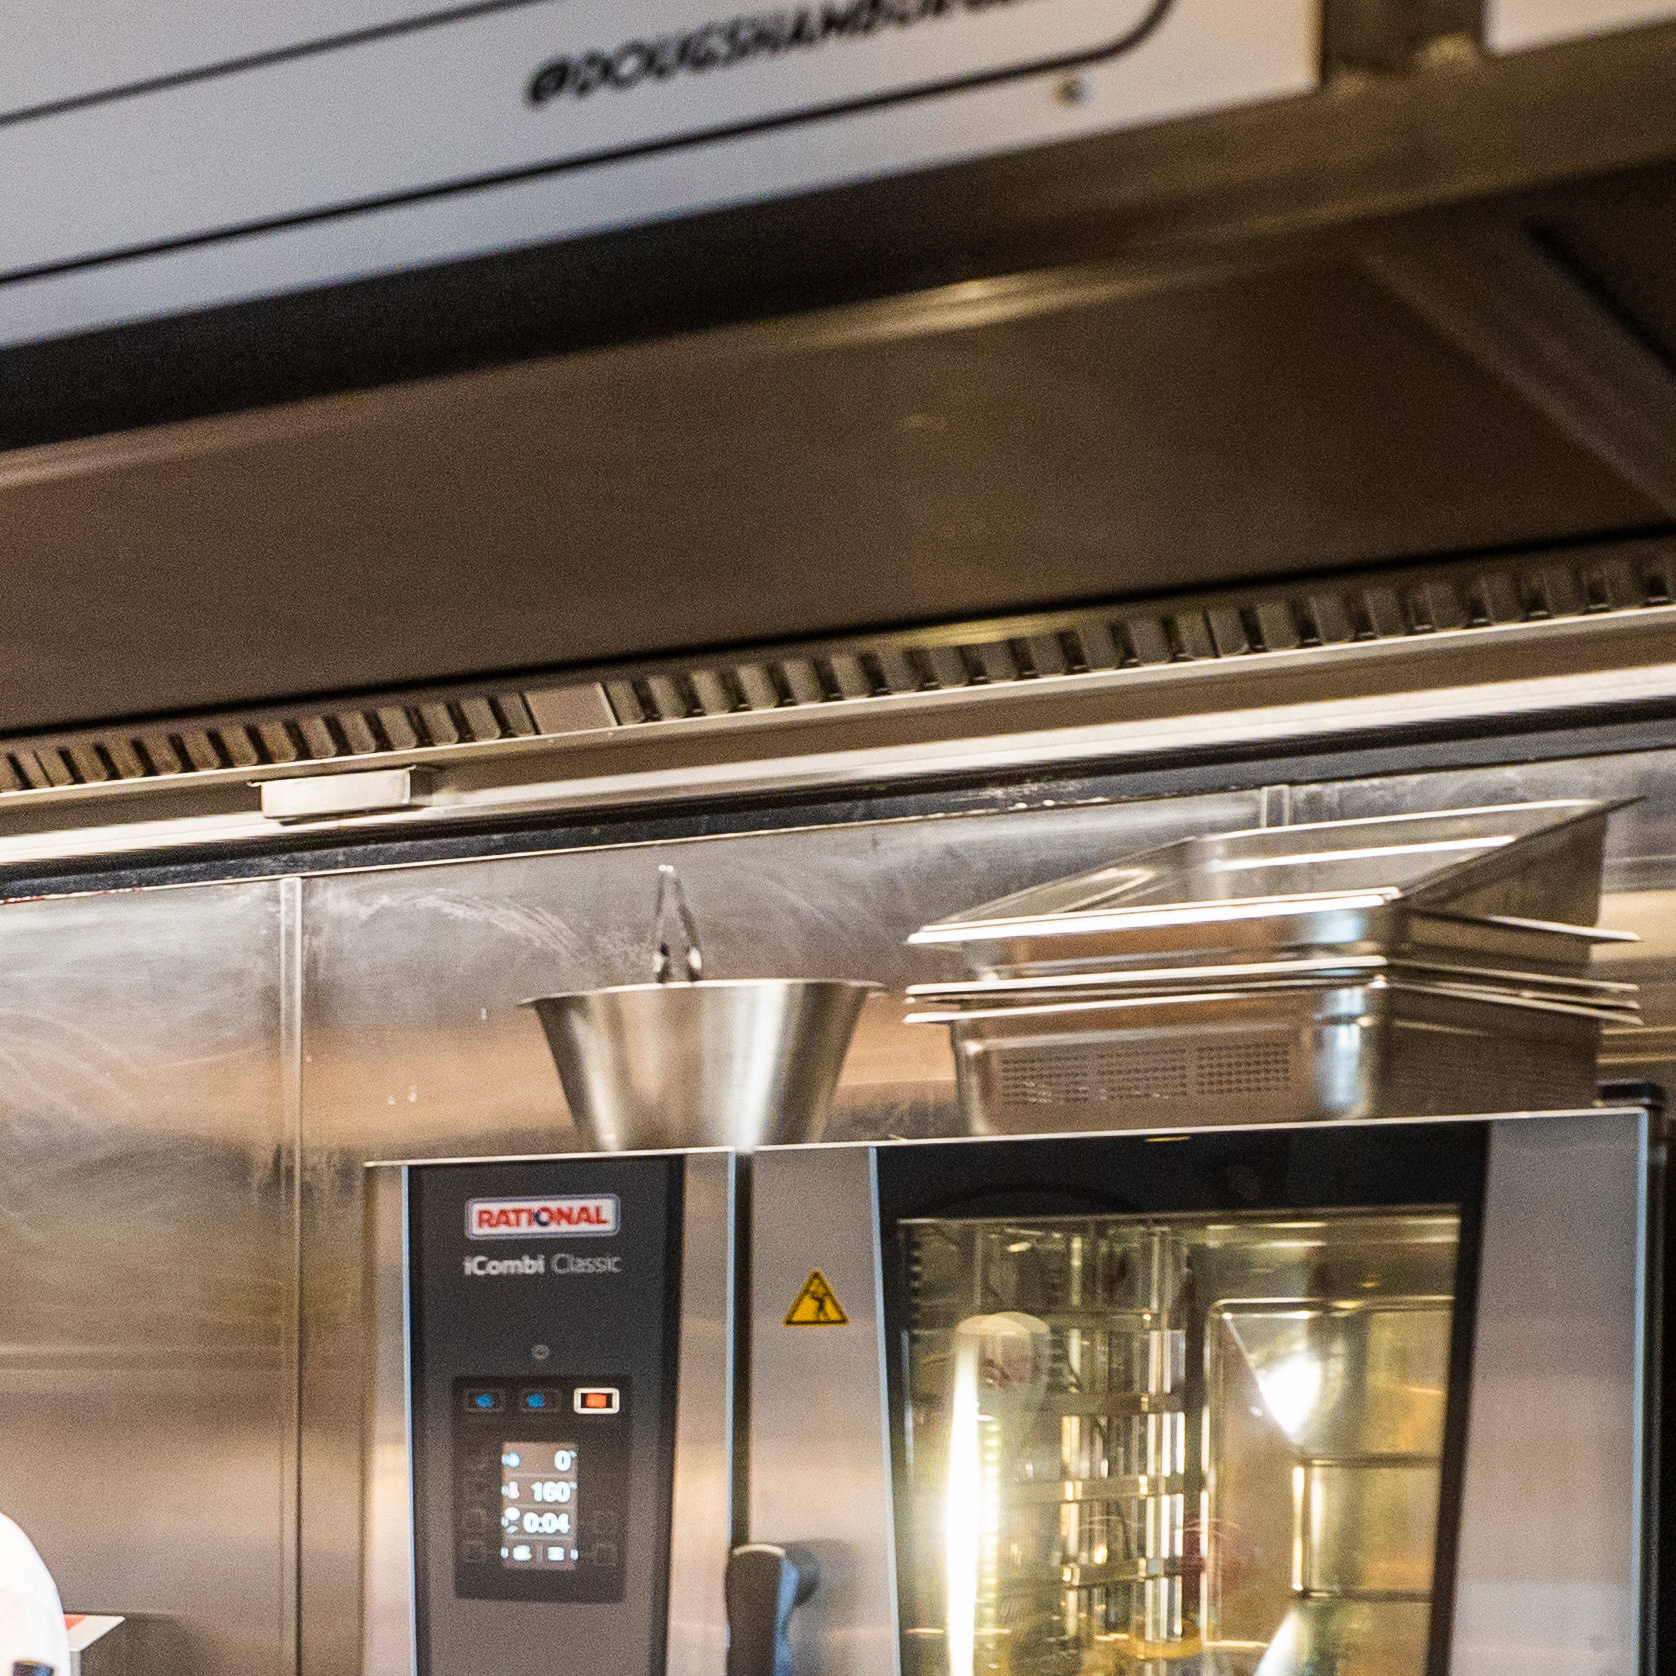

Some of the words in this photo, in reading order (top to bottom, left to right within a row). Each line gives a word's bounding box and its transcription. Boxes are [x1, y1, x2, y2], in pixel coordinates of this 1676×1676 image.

[478, 1205, 609, 1227] RATIONAL
[463, 1254, 545, 1275] iCombi
[550, 1253, 622, 1274] Classic
[523, 1512, 571, 1534] 0:04
